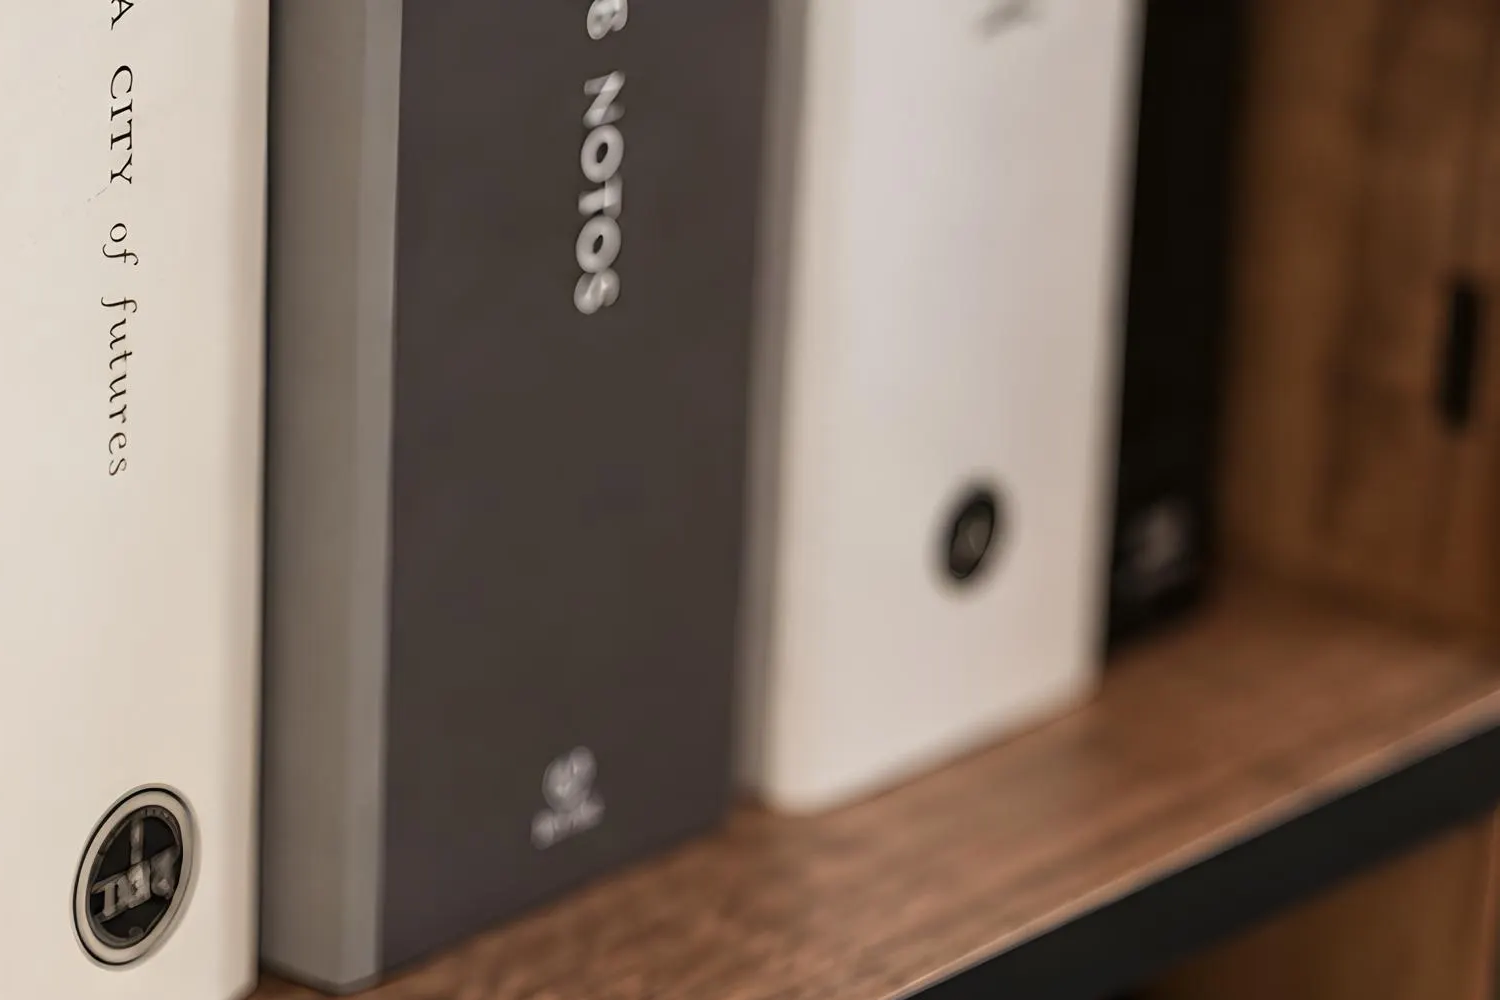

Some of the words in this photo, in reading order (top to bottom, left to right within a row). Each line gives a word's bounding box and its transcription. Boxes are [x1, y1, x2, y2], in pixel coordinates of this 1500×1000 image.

[109, 64, 134, 185] CITY
[573, 69, 626, 316] NOTOS
[102, 222, 139, 266] of
[100, 296, 138, 477] futures
